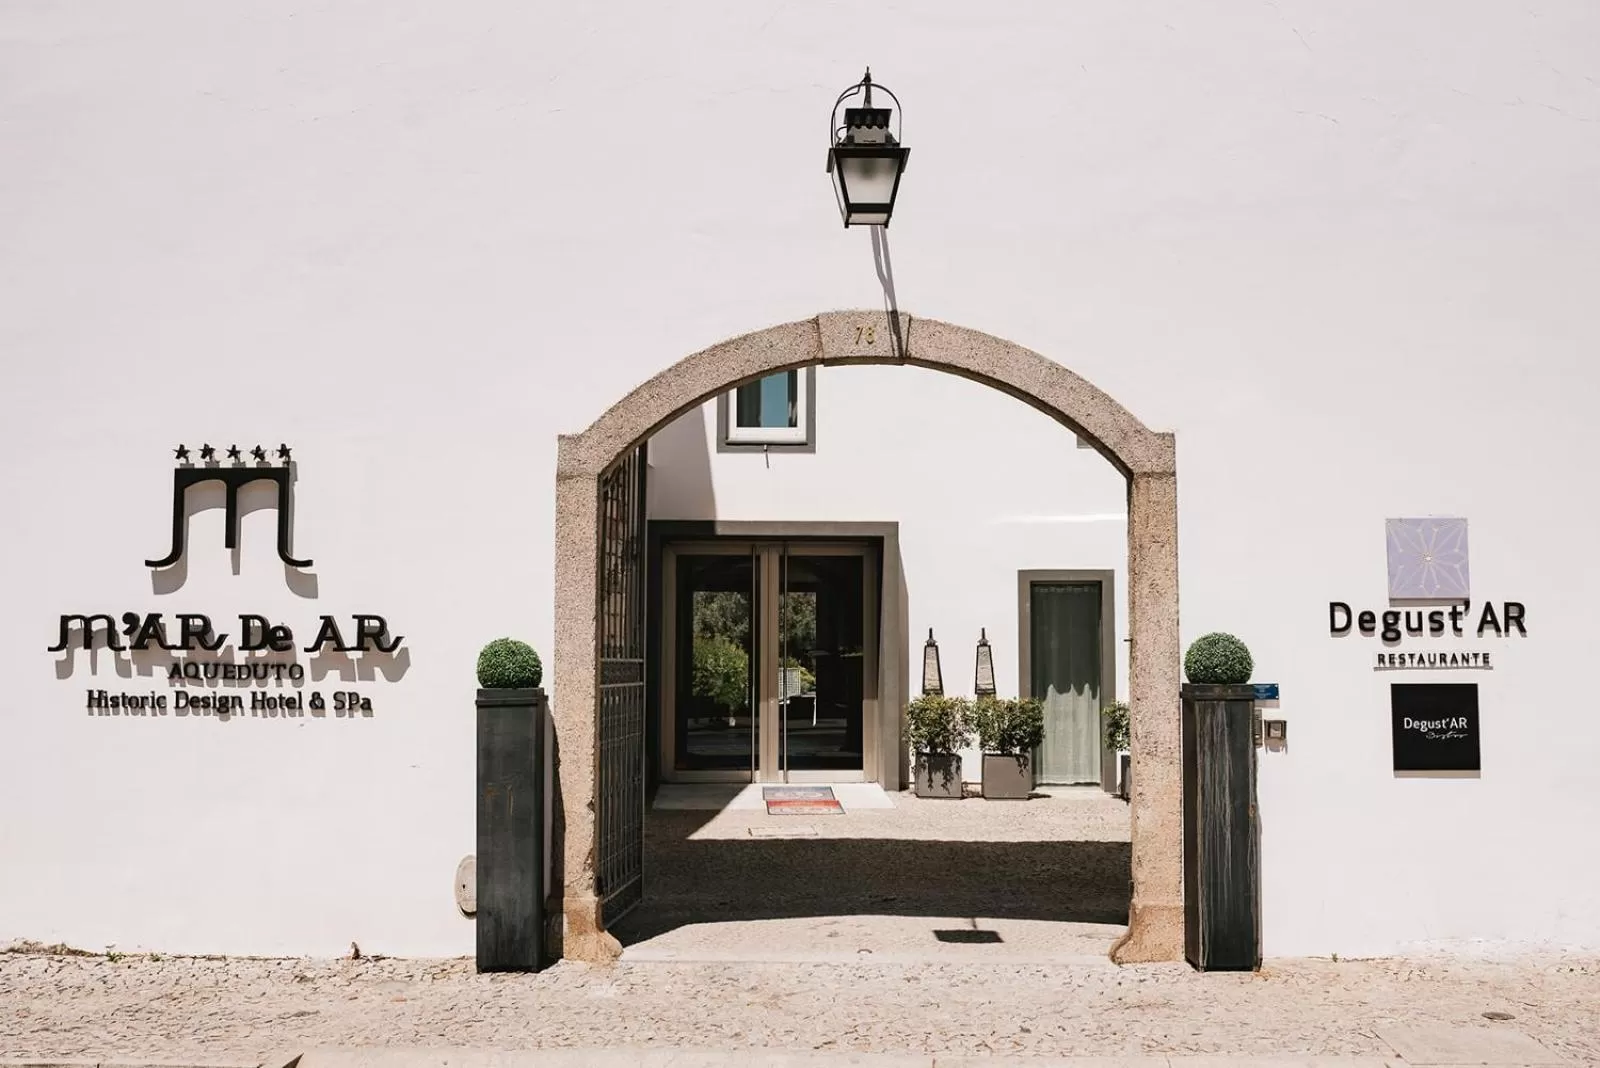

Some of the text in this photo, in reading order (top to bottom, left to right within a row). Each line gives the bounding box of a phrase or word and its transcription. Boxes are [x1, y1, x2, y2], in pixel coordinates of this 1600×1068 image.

[1329, 600, 1527, 642] Degust'AR
[238, 614, 292, 651] De
[304, 614, 404, 653] AR
[1377, 652, 1490, 666] RESTAURANTE
[168, 662, 305, 680] AQUEDUTO
[87, 690, 167, 709] Historic
[174, 690, 244, 713] Design
[250, 691, 303, 710] Hotel
[309, 691, 325, 710] &
[1404, 717, 1468, 732] Degust'AR
